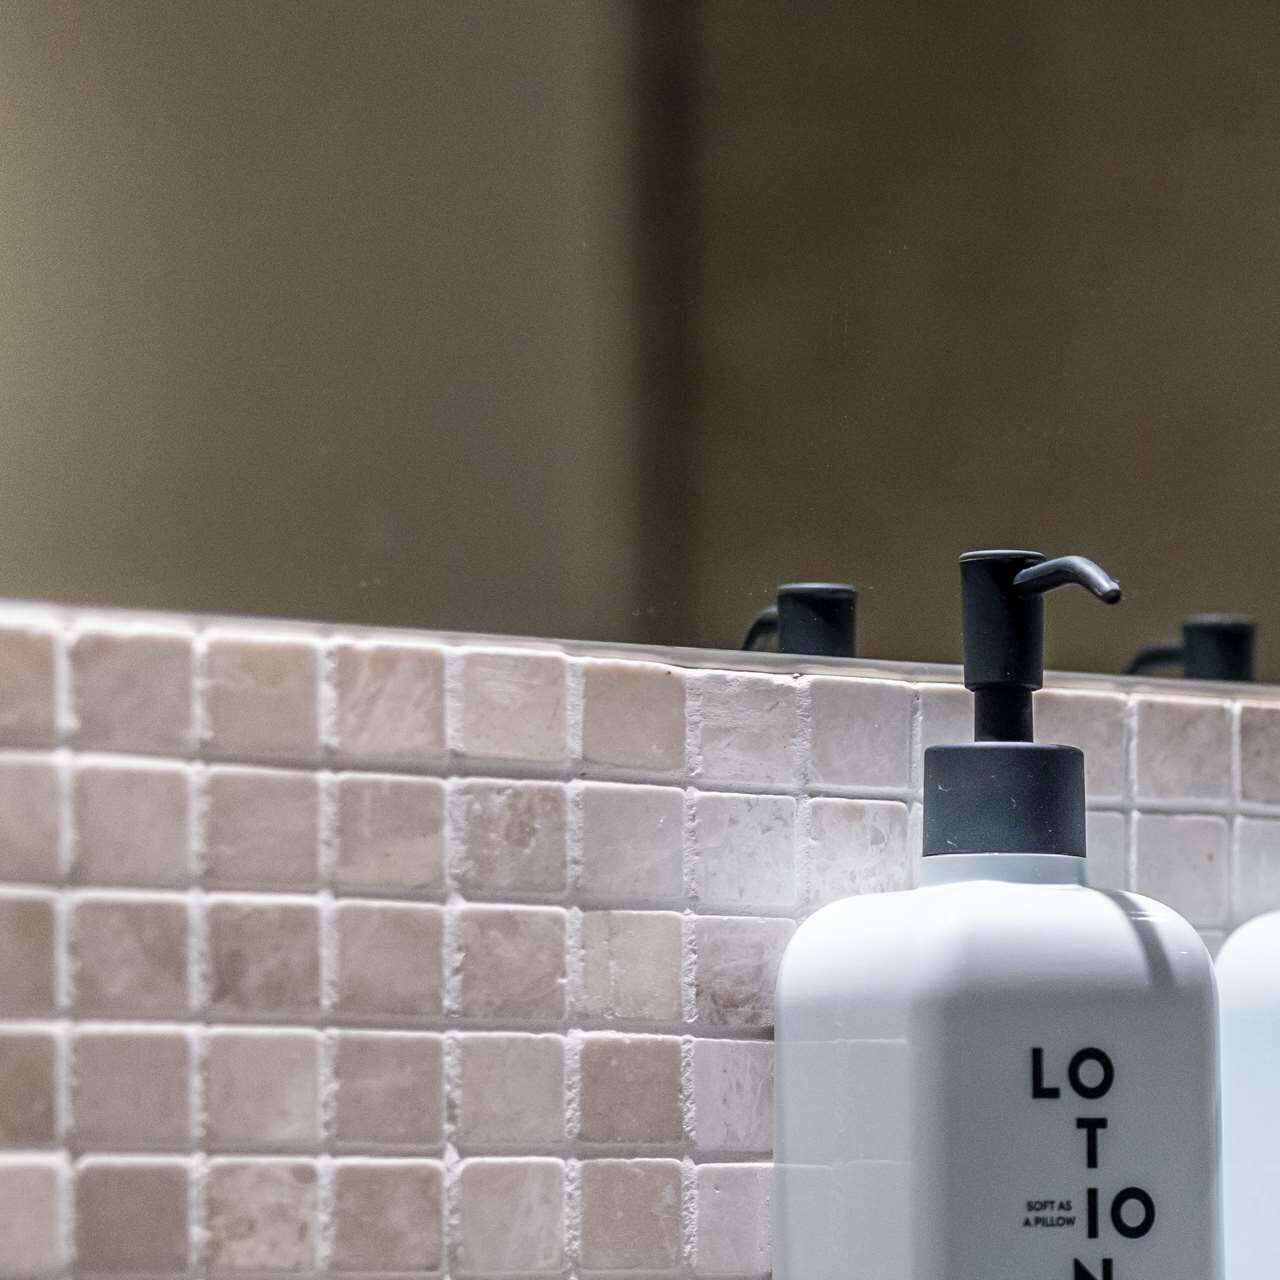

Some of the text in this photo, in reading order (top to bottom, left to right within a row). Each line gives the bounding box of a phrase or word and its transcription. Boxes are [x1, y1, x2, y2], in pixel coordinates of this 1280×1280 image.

[1027, 1200, 1073, 1211] SOFT AS
[1022, 1216, 1076, 1227] A PILLOW
